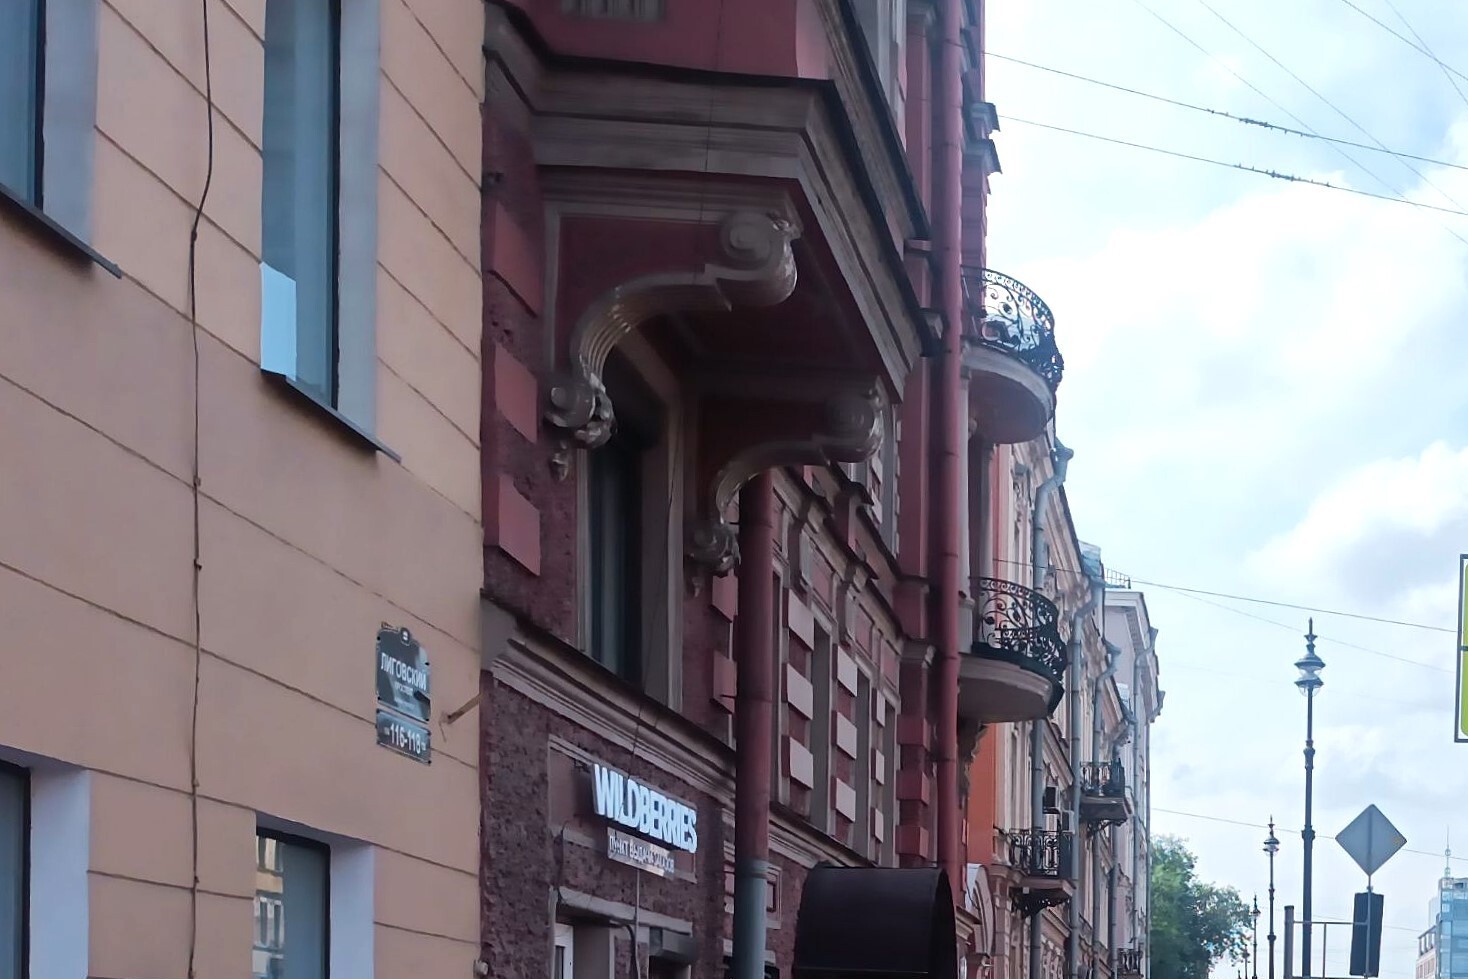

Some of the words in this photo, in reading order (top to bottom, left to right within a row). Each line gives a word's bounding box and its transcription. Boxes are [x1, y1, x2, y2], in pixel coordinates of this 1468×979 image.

[380, 652, 428, 691] ЛИГОВСКИЙ
[390, 722, 421, 755] 116-118
[593, 763, 698, 854] WILDBERRIES
